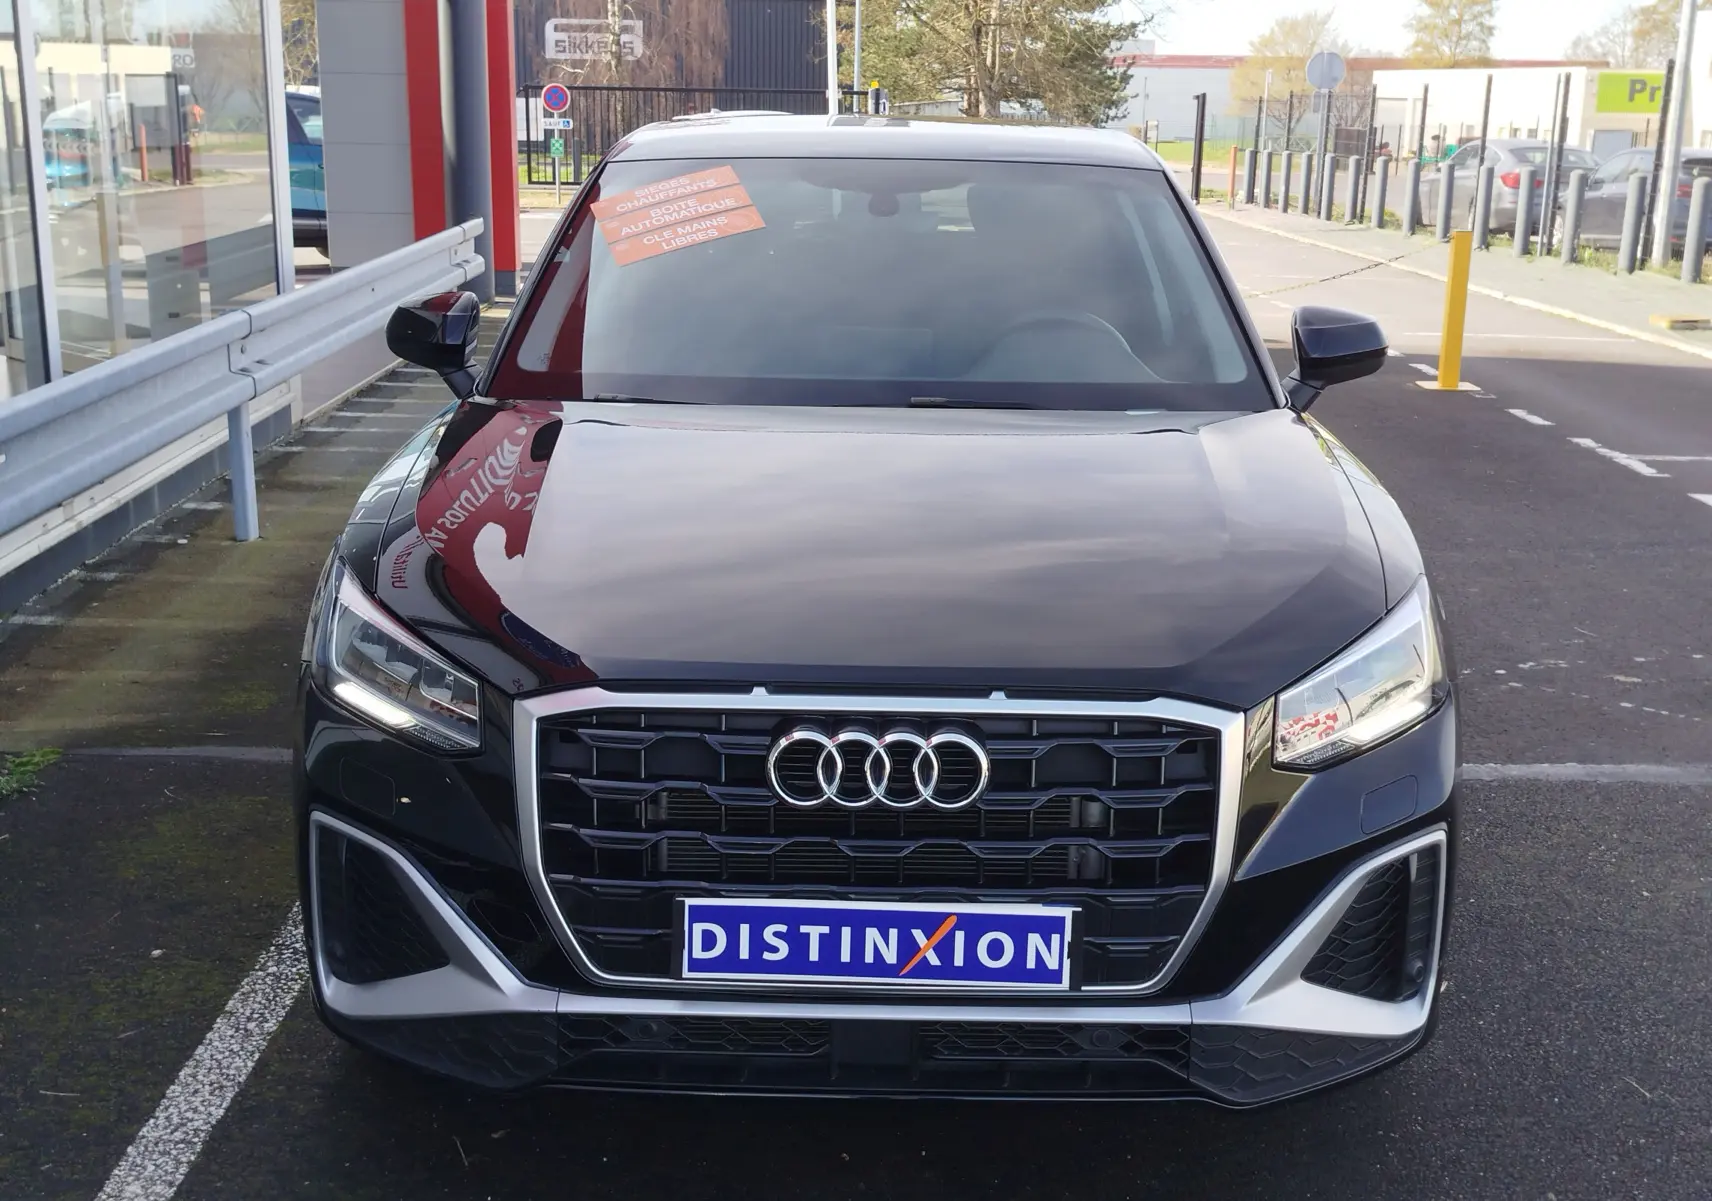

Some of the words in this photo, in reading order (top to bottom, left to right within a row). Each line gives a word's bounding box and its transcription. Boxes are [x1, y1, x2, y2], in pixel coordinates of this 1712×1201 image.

[555, 35, 634, 57] sikkes
[616, 179, 717, 212] CHAUFFANTS
[635, 177, 690, 197] SIEGES
[621, 198, 737, 235] AUTOMATIQUE
[649, 198, 698, 218] BOITE
[643, 229, 674, 245] CLE
[677, 217, 728, 235] MAINS
[662, 229, 719, 250] LIBRES
[691, 915, 1060, 975] DISTINXION
